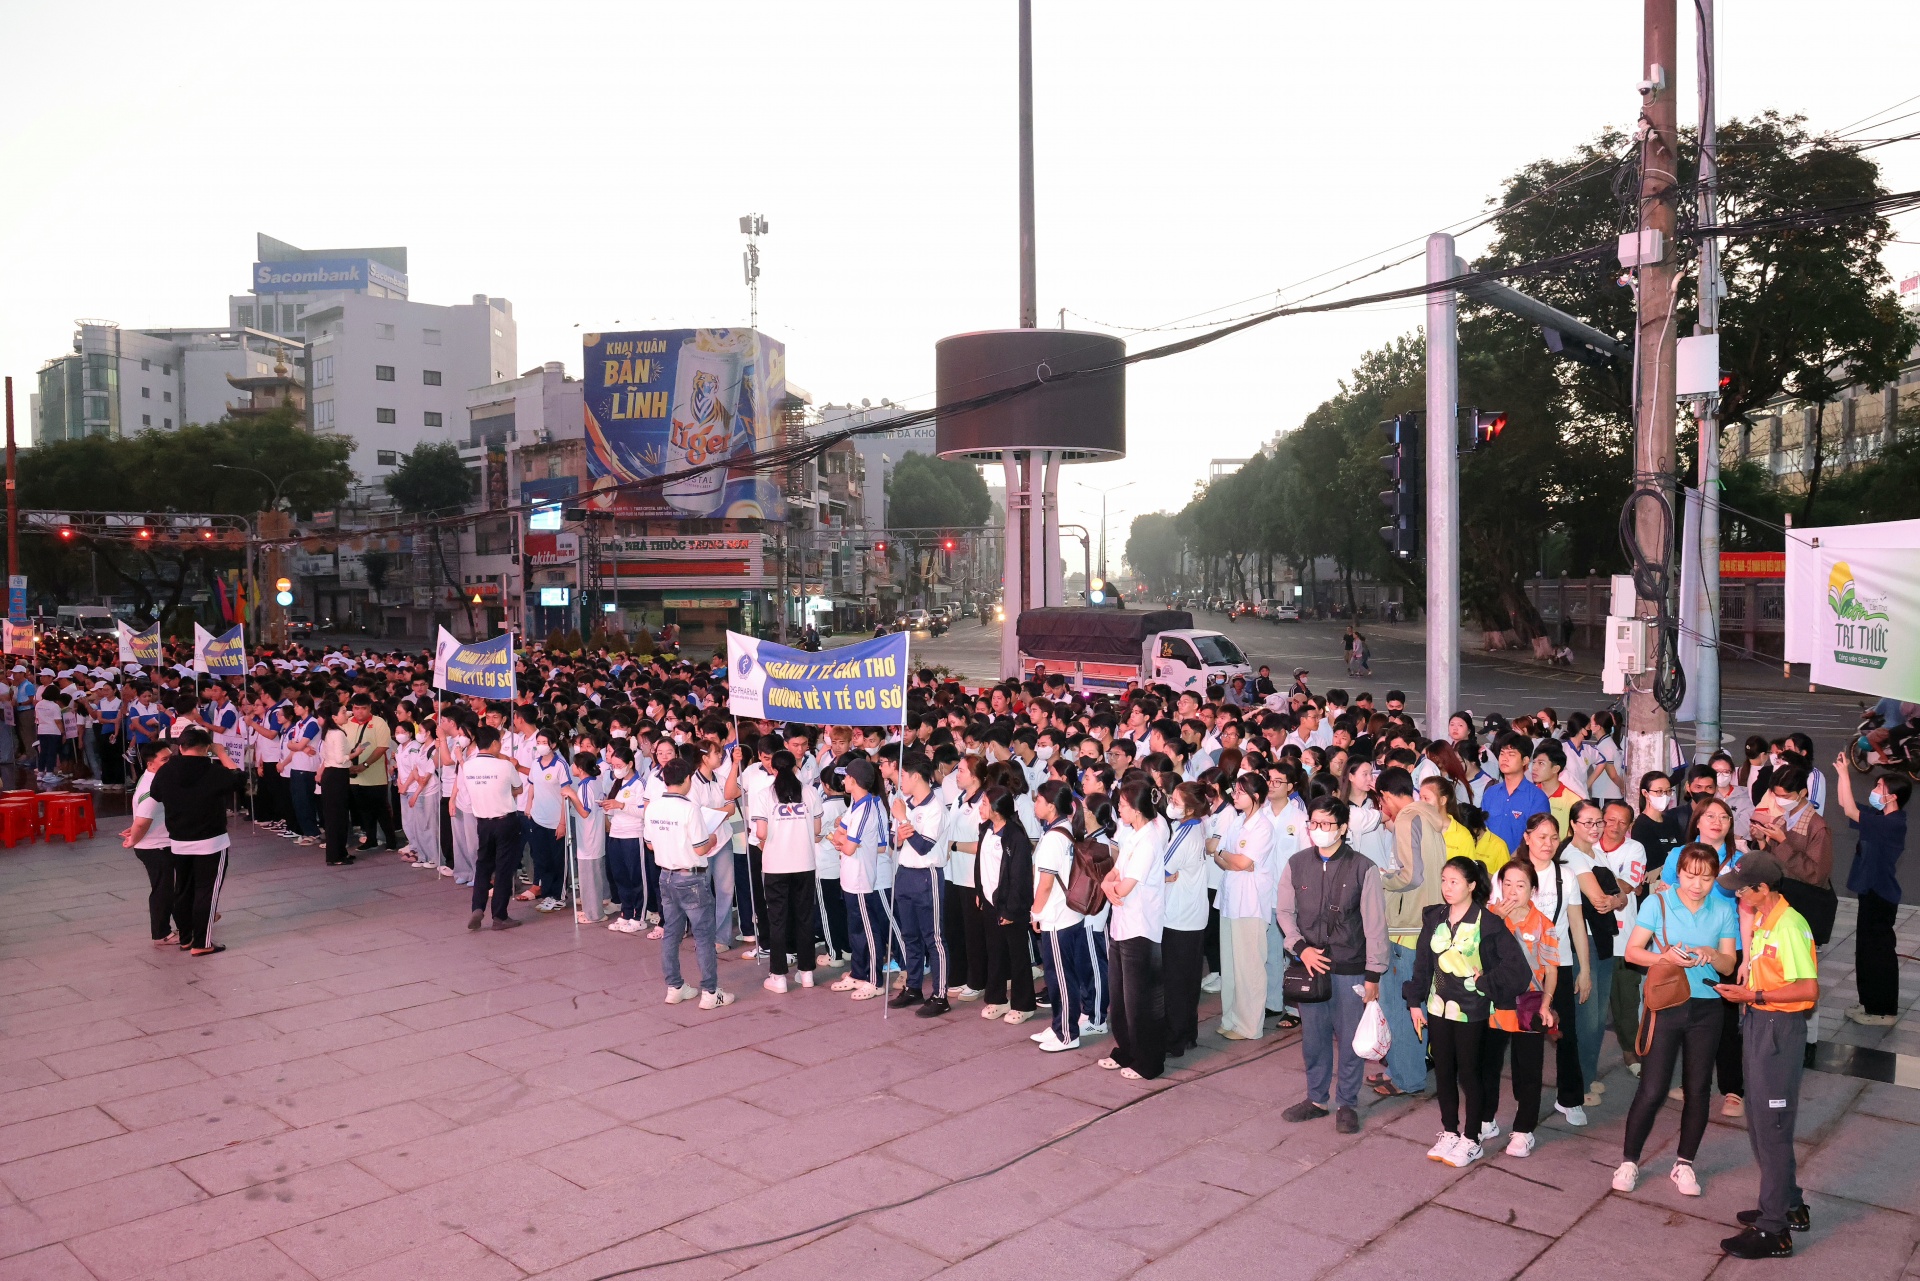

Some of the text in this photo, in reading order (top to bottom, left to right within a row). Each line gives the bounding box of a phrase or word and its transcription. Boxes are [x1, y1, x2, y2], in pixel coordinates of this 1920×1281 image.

[258, 265, 360, 284] Sacombank
[606, 338, 667, 355] KHAI XUÂN
[603, 352, 651, 387] BẢN
[611, 385, 669, 421] LĨNH
[670, 419, 732, 465] Tiger
[914, 430, 936, 438] KHO
[625, 538, 648, 551] NHÀ
[650, 537, 686, 551] THUỐC
[1835, 622, 1889, 654] TRI THỨC
[765, 661, 808, 680] NGÀNH
[805, 664, 820, 680] Y
[817, 659, 837, 680] TẾ
[863, 653, 895, 678] THƠ
[1857, 655, 1869, 665] Sách
[498, 669, 512, 688] SỞ
[768, 683, 902, 711] HƯỚNG VỀ Y TẾ CƠ SỞ
